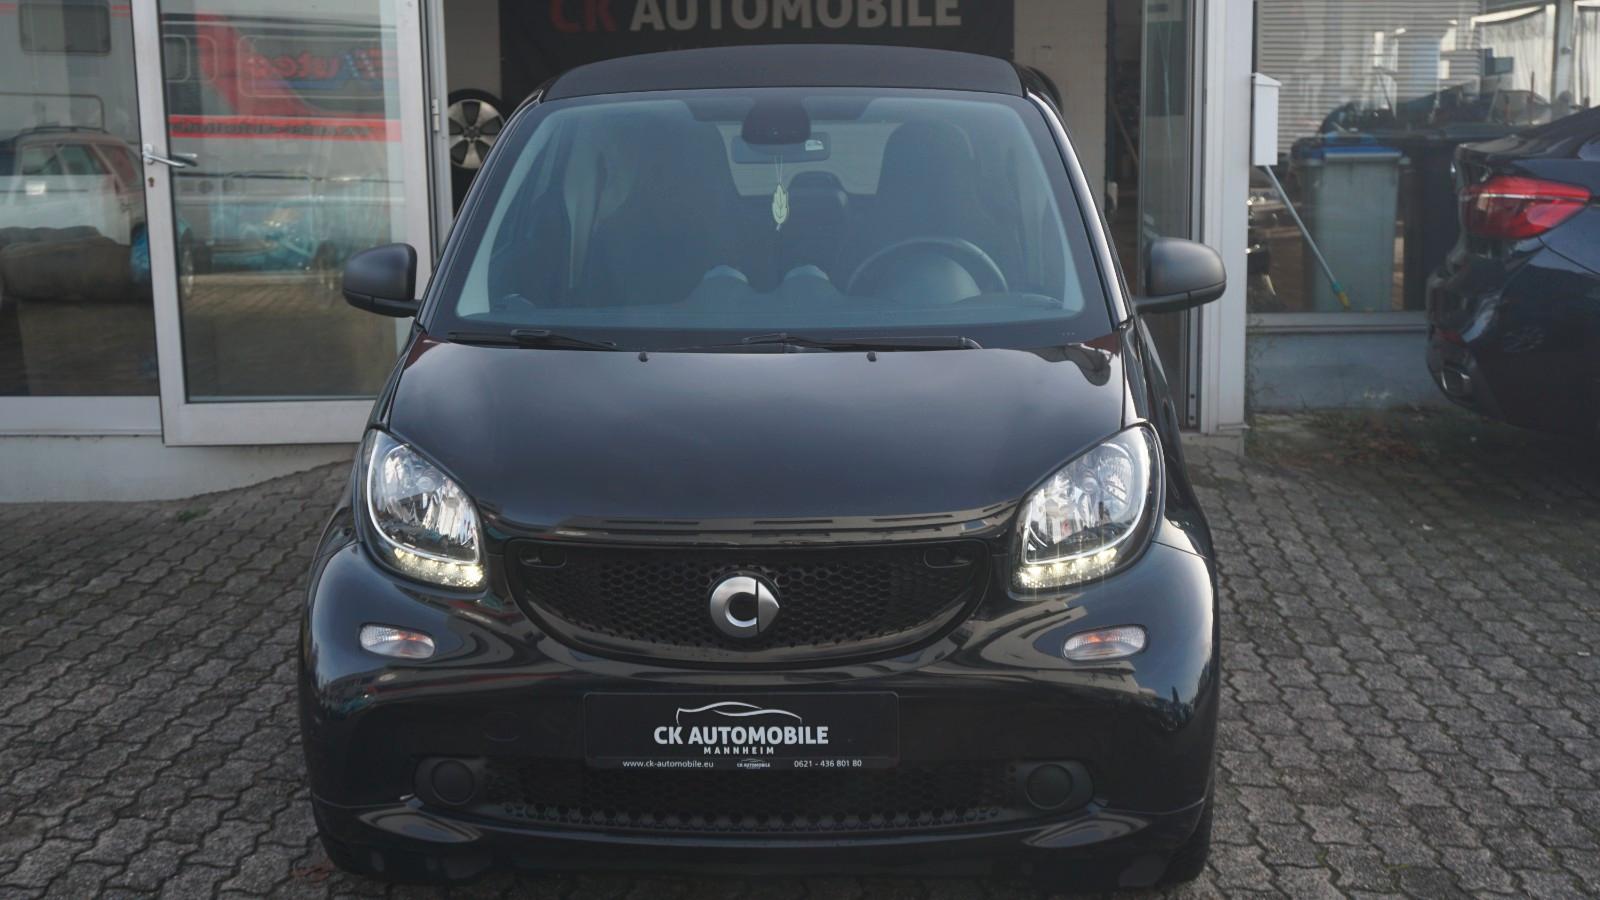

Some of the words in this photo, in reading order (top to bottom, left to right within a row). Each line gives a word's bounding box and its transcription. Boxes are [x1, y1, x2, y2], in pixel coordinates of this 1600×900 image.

[549, 0, 617, 33] CK
[629, 0, 961, 31] AUTOMOBILE
[653, 726, 683, 745] CK
[688, 726, 829, 745] AUTOMOBILE
[704, 746, 774, 755] MANNHEIM
[622, 759, 714, 768] www.ck-automobile.eu
[793, 759, 812, 768] 0621
[820, 759, 834, 768] 436
[836, 759, 850, 768] 801
[852, 759, 862, 768] 80
